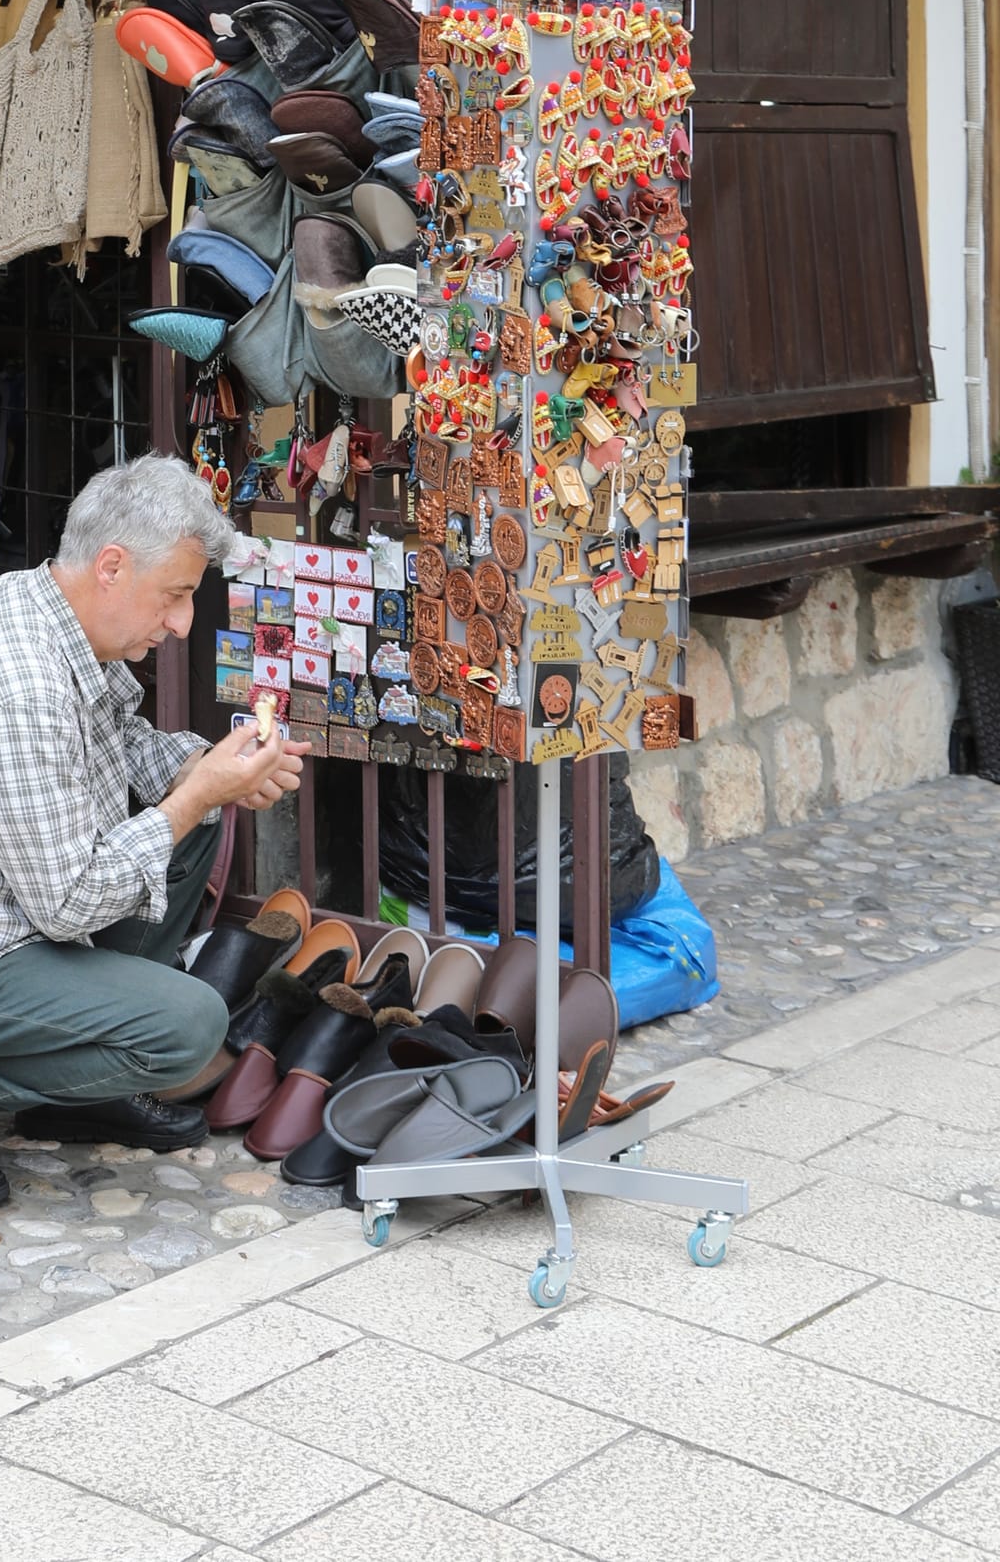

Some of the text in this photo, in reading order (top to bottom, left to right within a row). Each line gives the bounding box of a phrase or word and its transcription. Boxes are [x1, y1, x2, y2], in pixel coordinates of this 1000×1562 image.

[295, 567, 329, 578] SARAJEVO
[335, 573, 370, 584] SARAJEVO
[295, 604, 328, 615] SARAJEVO
[297, 638, 328, 651] SARAJEVO
[254, 675, 286, 687] SARAJEVO
